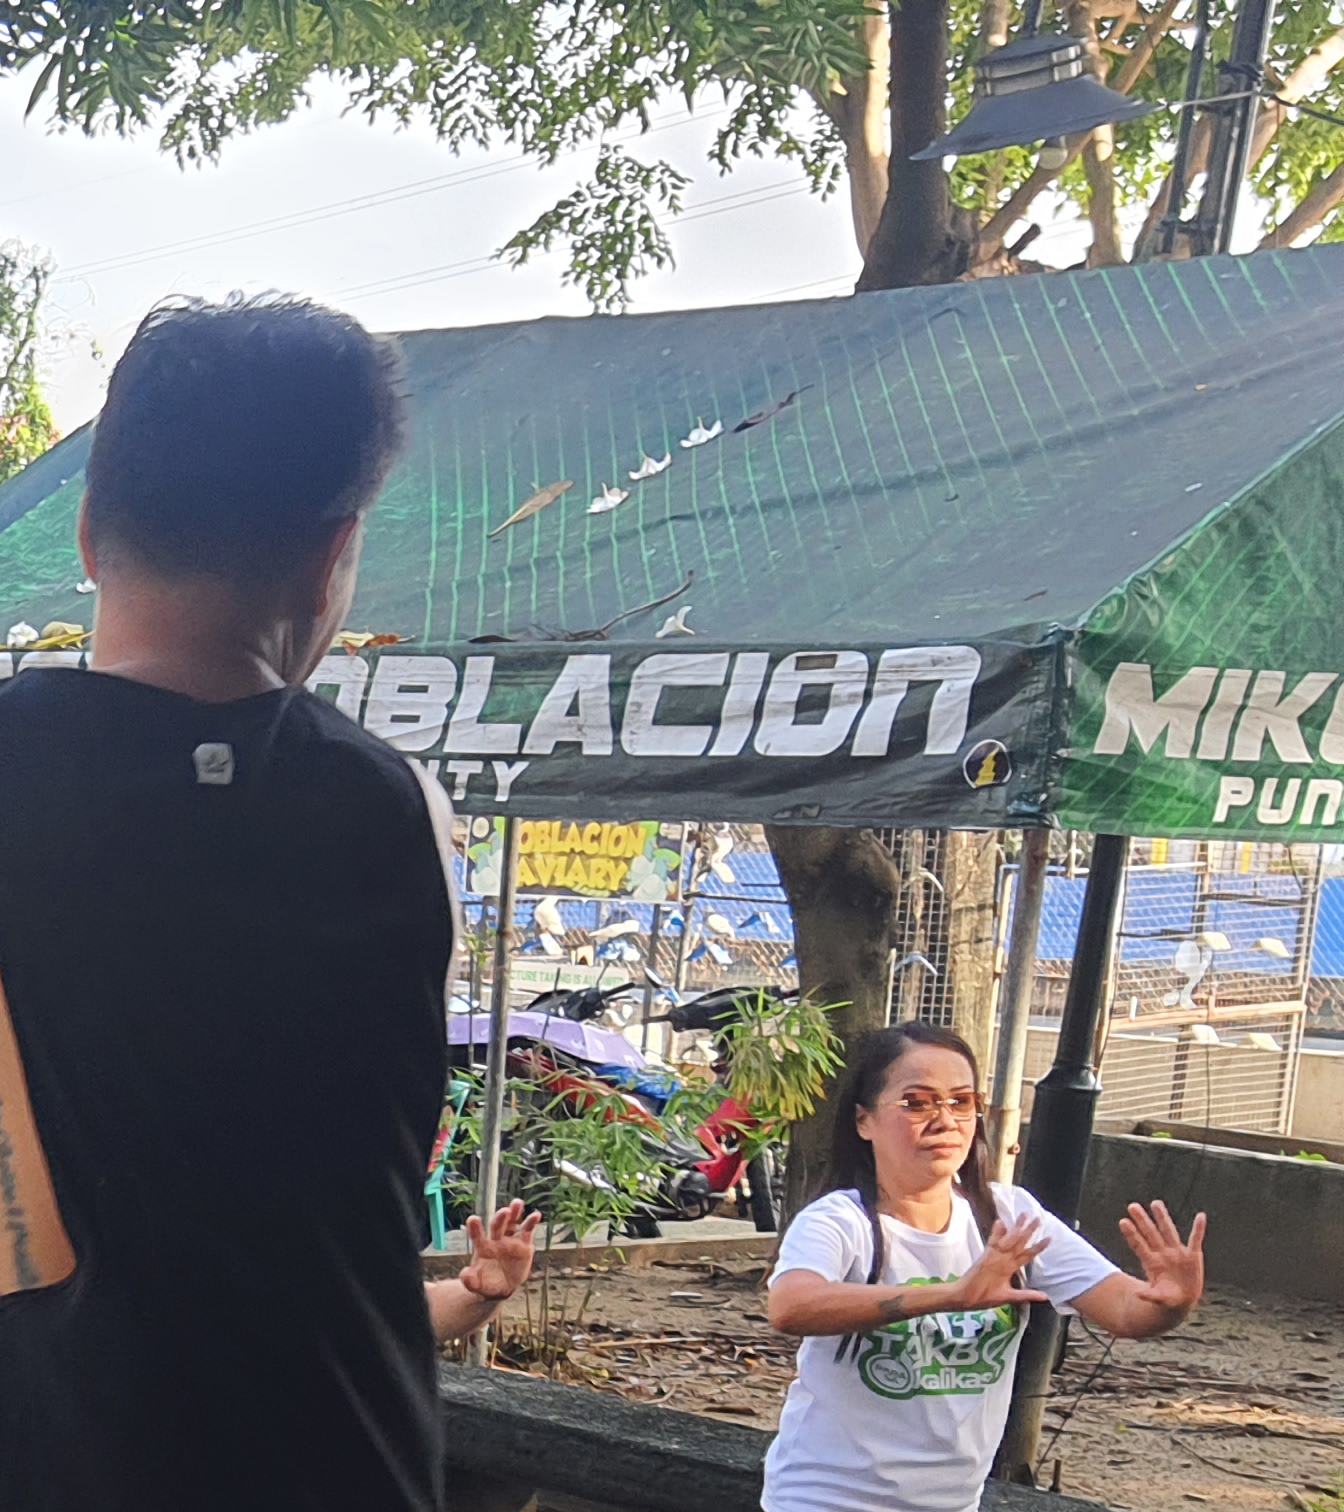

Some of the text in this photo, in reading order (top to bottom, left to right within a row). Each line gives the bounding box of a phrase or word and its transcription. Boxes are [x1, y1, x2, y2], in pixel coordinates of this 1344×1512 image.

[1093, 662, 1344, 764] MIK
[519, 820, 647, 858] OBLACION
[517, 855, 629, 891] AVIARY
[913, 1367, 996, 1390] kalikas
